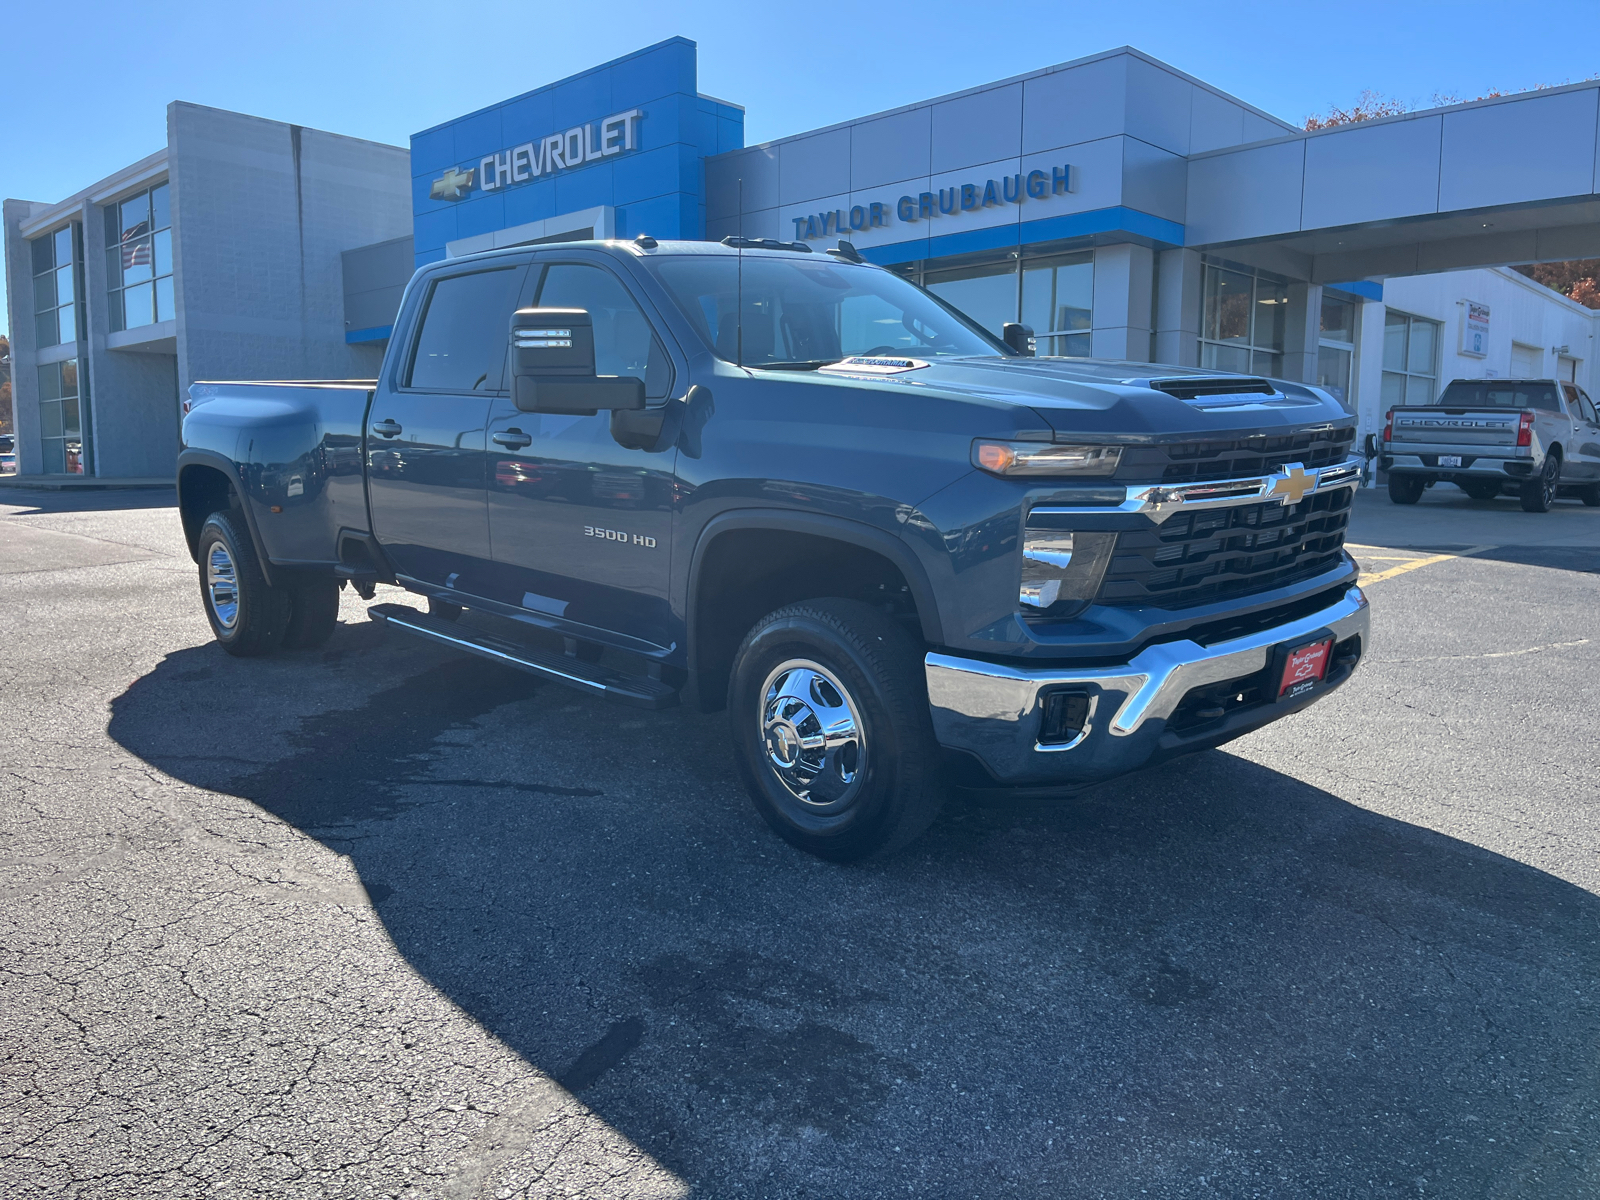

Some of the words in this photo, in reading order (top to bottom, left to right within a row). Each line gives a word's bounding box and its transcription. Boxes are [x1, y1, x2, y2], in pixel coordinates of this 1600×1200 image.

[479, 109, 642, 192] CHEVROLET
[792, 202, 887, 240] TAYLOR
[897, 164, 1073, 222] GRUBAUGH
[1400, 419, 1509, 428] CHEVROLET
[584, 525, 628, 543] 3500
[633, 534, 657, 549] HD
